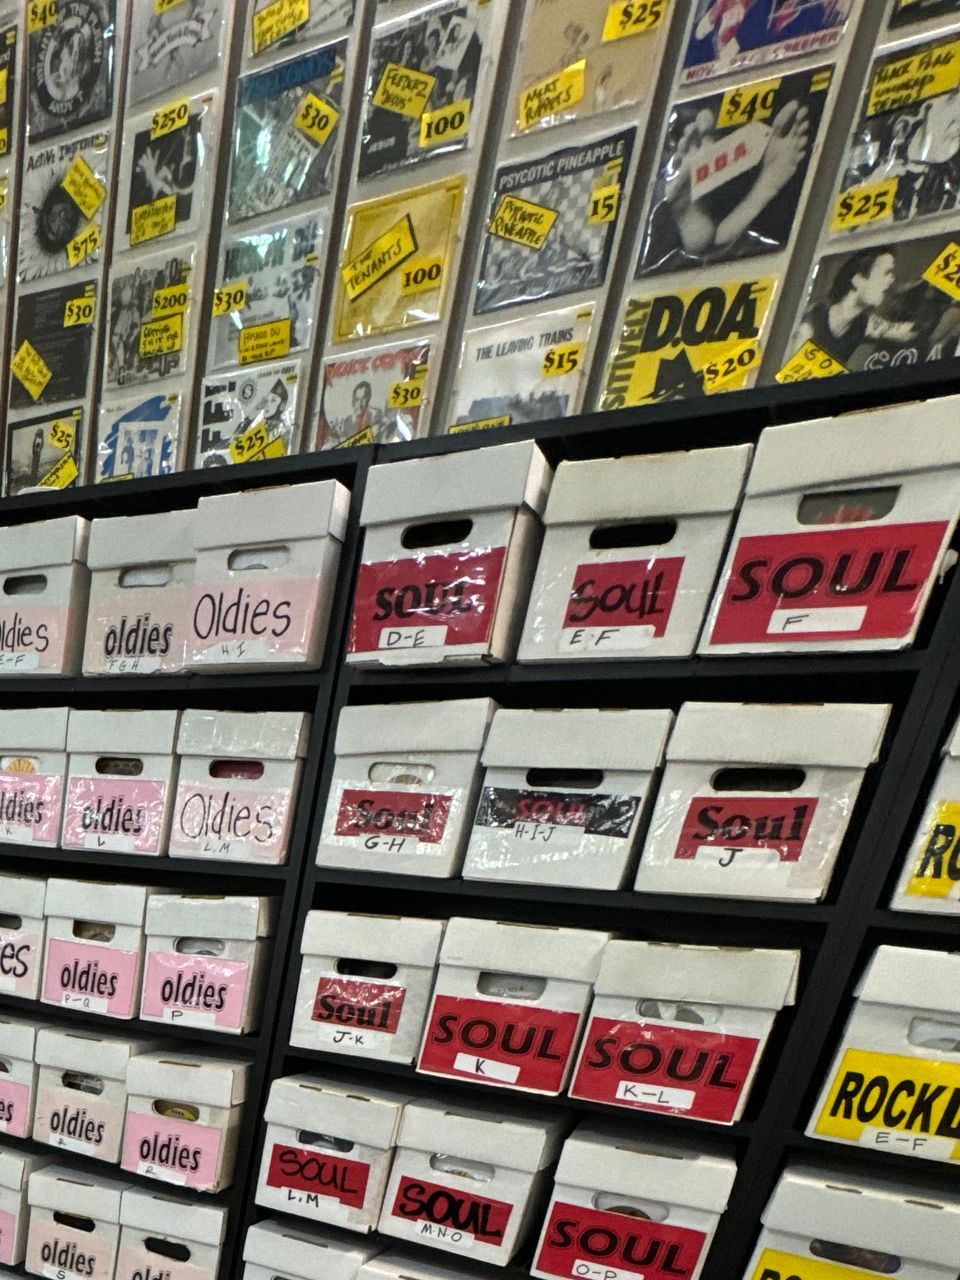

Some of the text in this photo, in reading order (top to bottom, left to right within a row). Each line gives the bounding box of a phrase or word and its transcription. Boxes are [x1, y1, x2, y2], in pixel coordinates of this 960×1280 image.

[30, 6, 56, 27] $40
[619, 3, 661, 26] $25
[726, 91, 775, 114] $40
[152, 106, 188, 130] $250
[302, 107, 329, 130] $30
[426, 111, 464, 138] 100
[499, 140, 624, 189] PSYCOTIC PINEAPPLE
[591, 198, 614, 216] 15
[838, 191, 888, 218] $25
[73, 236, 98, 253] $75
[403, 264, 440, 288] 100
[154, 294, 186, 308] $200
[215, 291, 244, 308] $30
[68, 303, 92, 321] $30
[476, 328, 573, 361] THE LEAVING TRAINS
[544, 351, 578, 370] $15
[704, 350, 755, 383] $20
[392, 386, 420, 402] $30
[51, 423, 72, 447] $25
[235, 430, 264, 456] $25
[730, 548, 919, 603] SOUL
[194, 588, 291, 639] Oldies
[782, 614, 810, 632] F
[386, 630, 425, 648] D-E
[693, 805, 808, 843] Soul
[365, 836, 405, 852] G-H
[718, 848, 744, 867] J
[61, 961, 118, 998] oldies
[162, 973, 227, 1011] oldies
[172, 1010, 184, 1021] P
[433, 1014, 564, 1063] SOUL
[475, 1057, 486, 1074] K
[587, 1035, 739, 1090] SOUL
[623, 1084, 670, 1105] K-L
[828, 1070, 943, 1137] ROCK
[875, 1131, 928, 1151] E-F
[549, 1219, 690, 1277] SOUL
[575, 1263, 618, 1280] O-P
